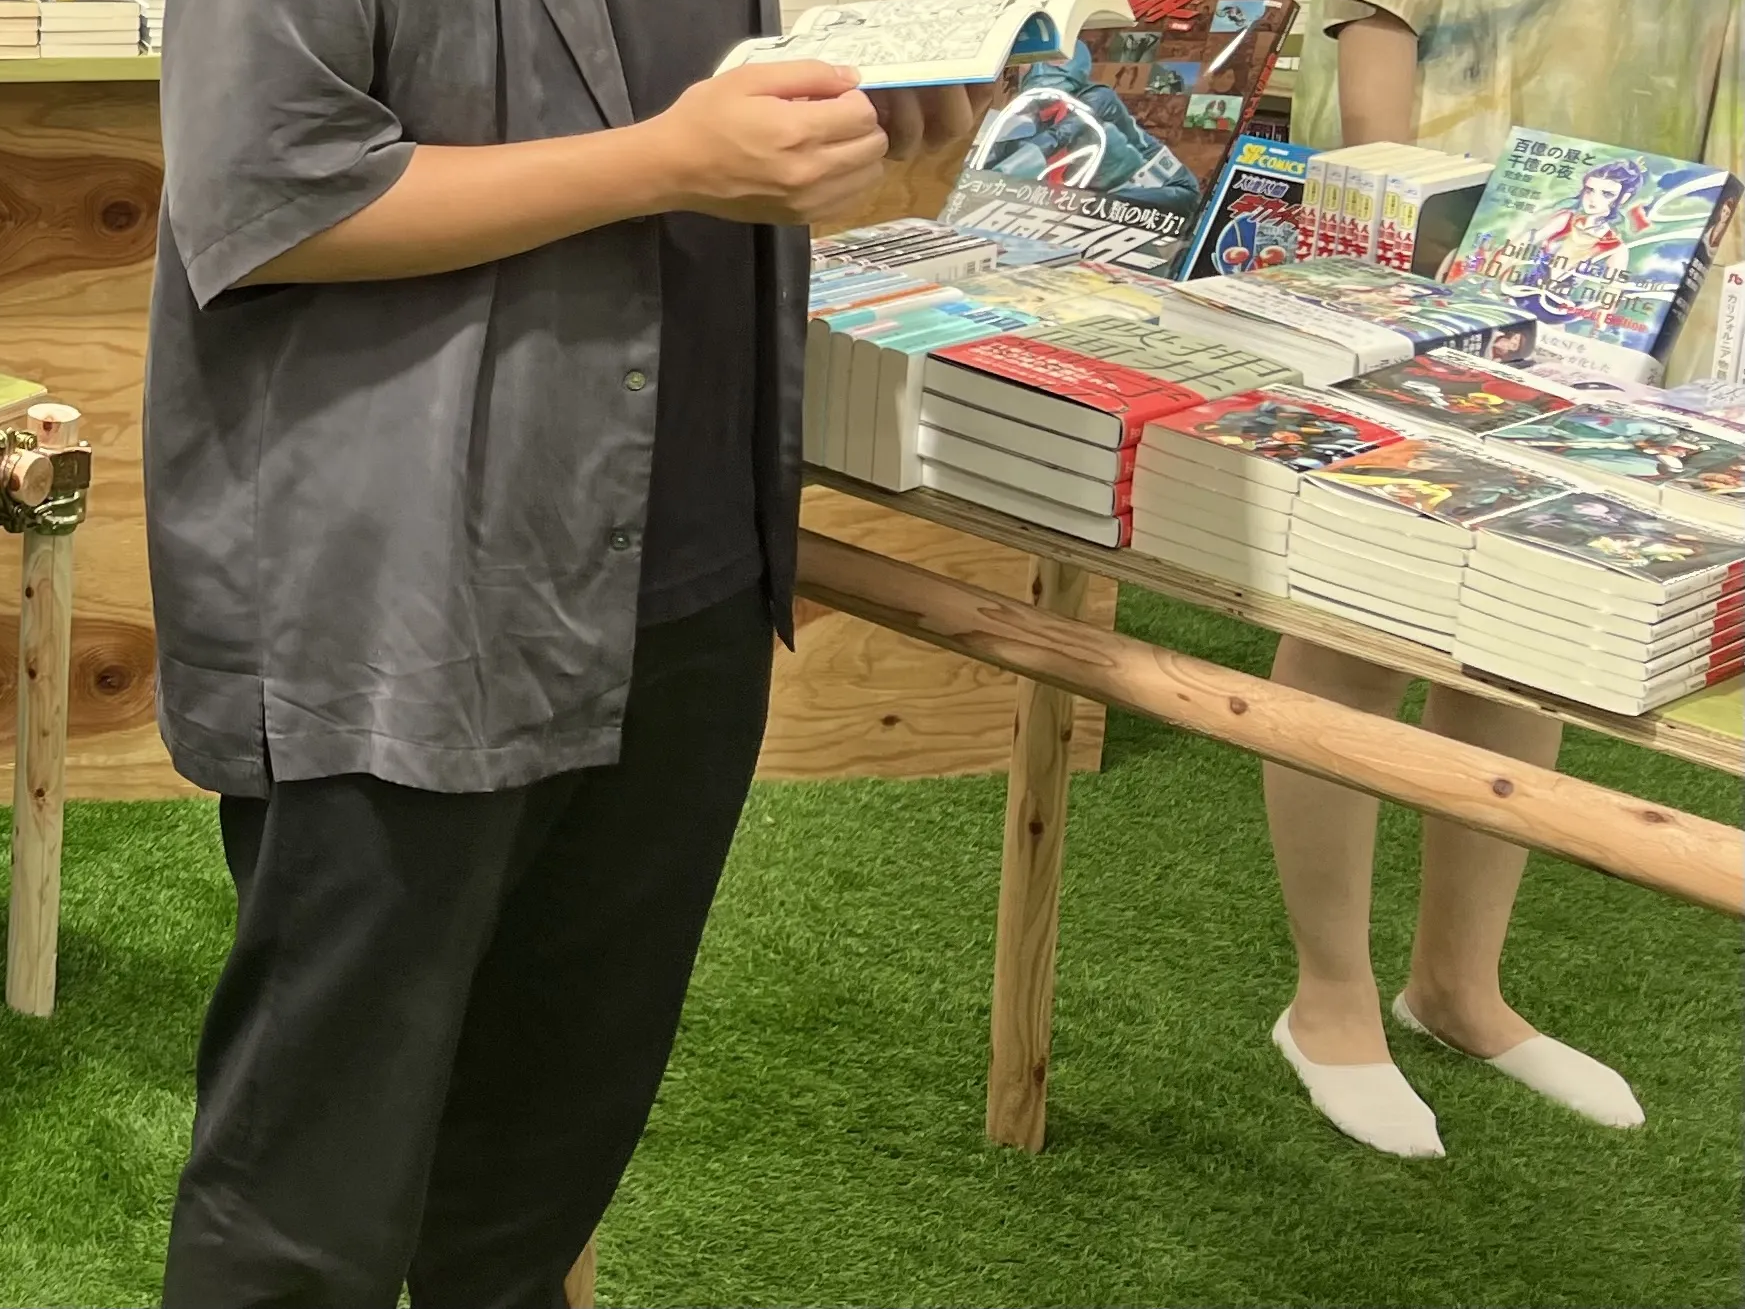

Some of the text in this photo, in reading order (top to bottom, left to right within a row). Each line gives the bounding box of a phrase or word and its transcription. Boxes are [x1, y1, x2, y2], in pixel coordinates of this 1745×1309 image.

[1514, 138, 1596, 167] 百億の昼と
[1508, 154, 1576, 180] 千億の夜
[1575, 257, 1633, 285] days
